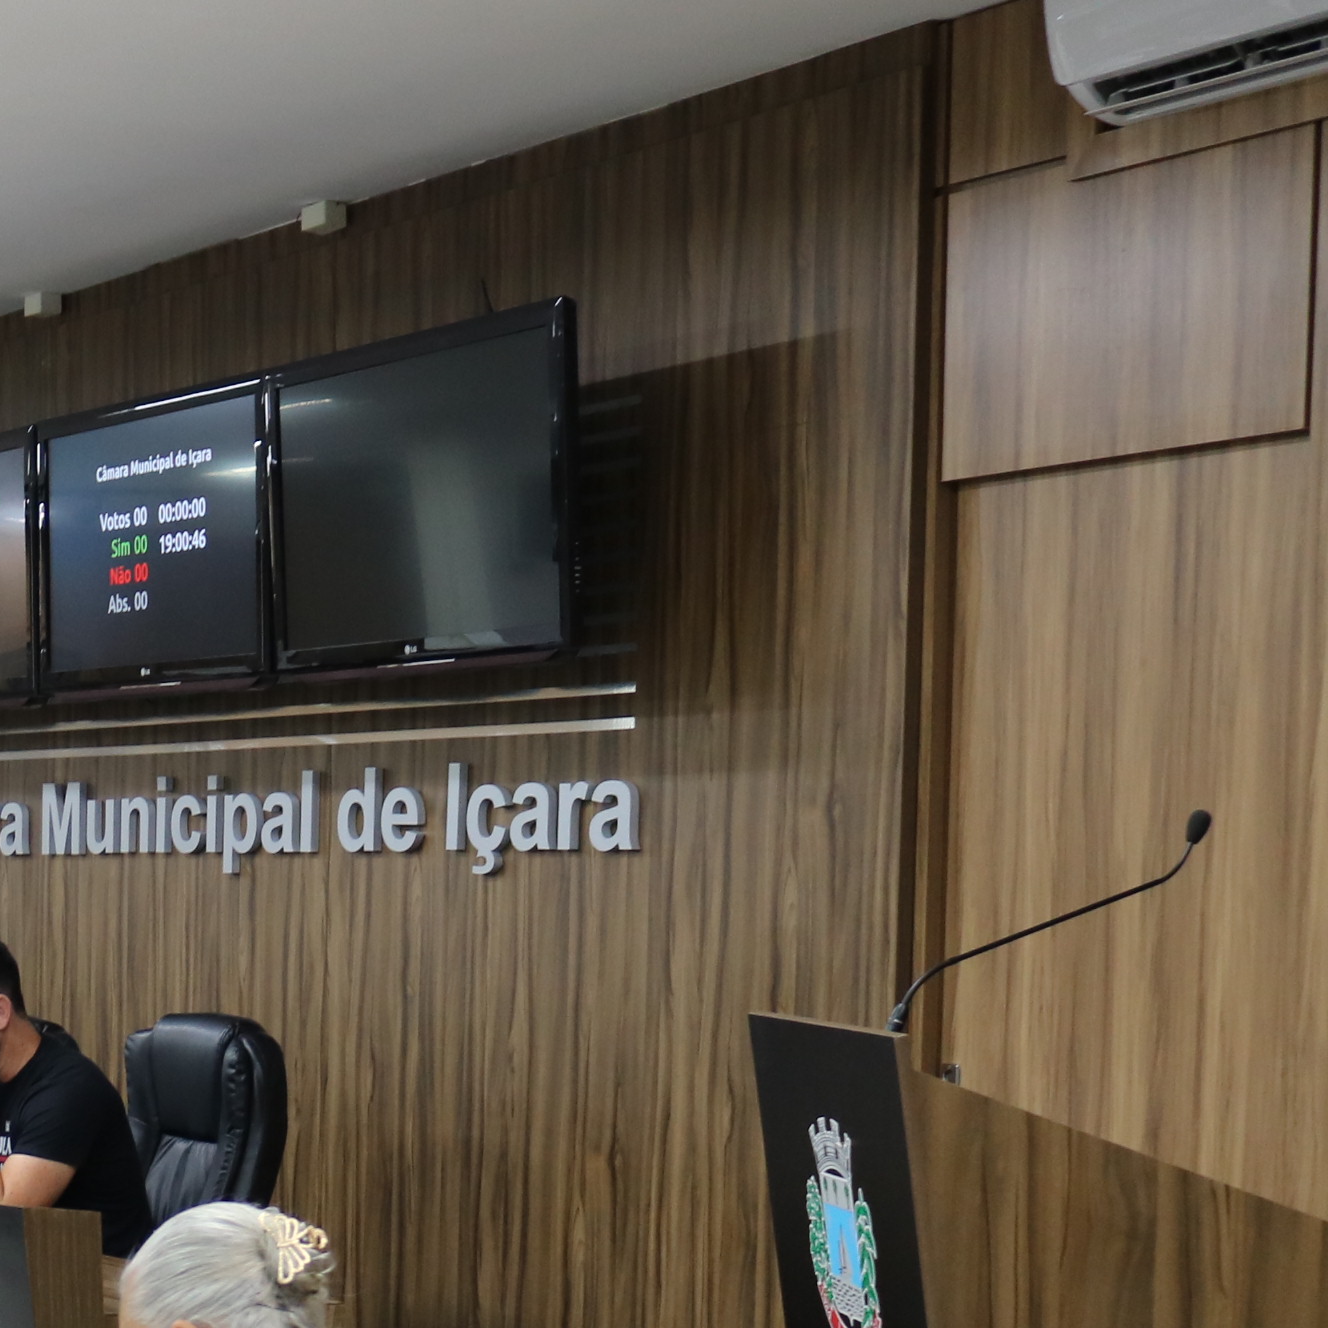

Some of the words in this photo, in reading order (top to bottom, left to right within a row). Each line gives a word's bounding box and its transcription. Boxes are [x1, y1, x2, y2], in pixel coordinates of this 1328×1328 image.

[96, 465, 129, 483] Câmara
[130, 452, 174, 476] Municipal
[175, 450, 187, 467] de
[189, 447, 213, 469] Içara
[99, 511, 131, 532] Votos
[133, 506, 148, 527] 00
[158, 496, 207, 525] 00:00:00
[111, 537, 131, 558] Sim
[134, 534, 148, 555] 00
[159, 528, 207, 555] 19:00:46
[110, 566, 132, 586] Não
[134, 562, 149, 583] 00
[107, 594, 131, 614] Abs.
[134, 591, 148, 611] 00
[42, 769, 318, 875] Municipal
[337, 767, 425, 854] de
[446, 762, 641, 876] Içara
